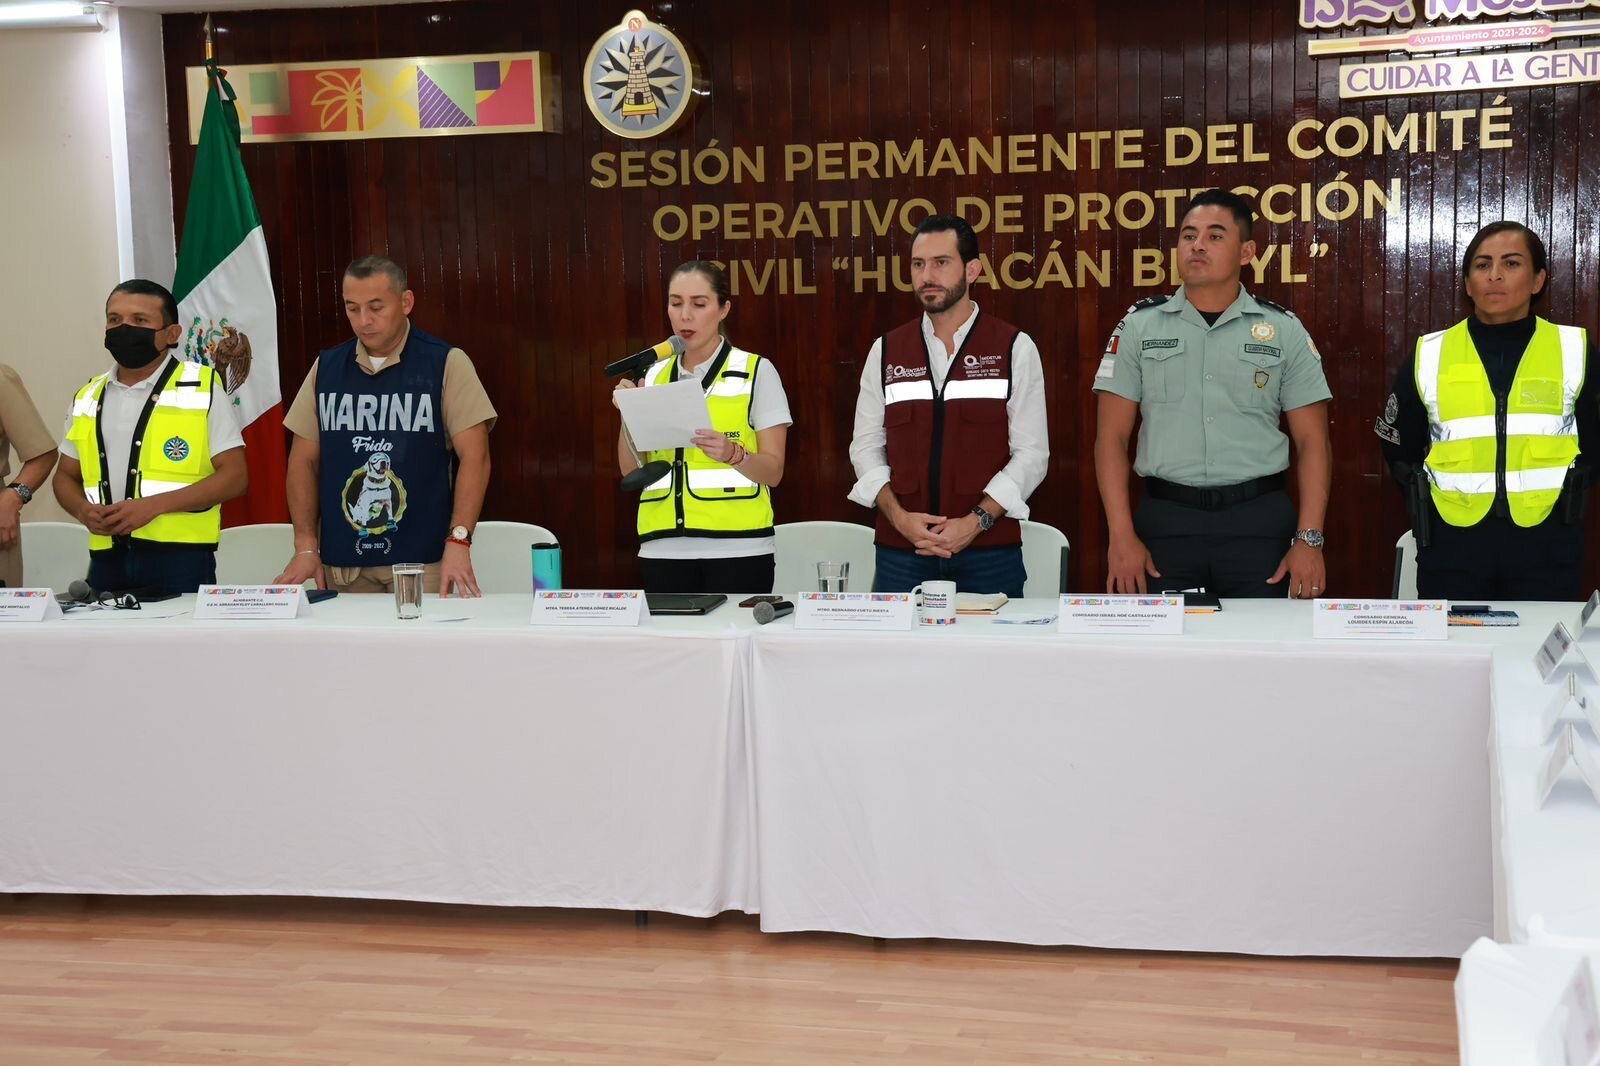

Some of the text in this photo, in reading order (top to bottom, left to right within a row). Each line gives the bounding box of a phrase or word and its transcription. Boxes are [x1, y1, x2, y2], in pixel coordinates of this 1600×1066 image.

[1415, 26, 1545, 44] Ayuntamiento 2021-2024
[1347, 62, 1452, 92] CUIDAR
[1461, 61, 1481, 85] A
[1492, 58, 1514, 82] LA
[590, 95, 1514, 189] SESIÓN PERMANENTE DEL COMITÉ
[652, 171, 1401, 242] OPERATIVO DE PROTCIÓN
[709, 258, 817, 296] IVIL
[318, 392, 435, 432] MARINA
[352, 435, 394, 453] Frida
